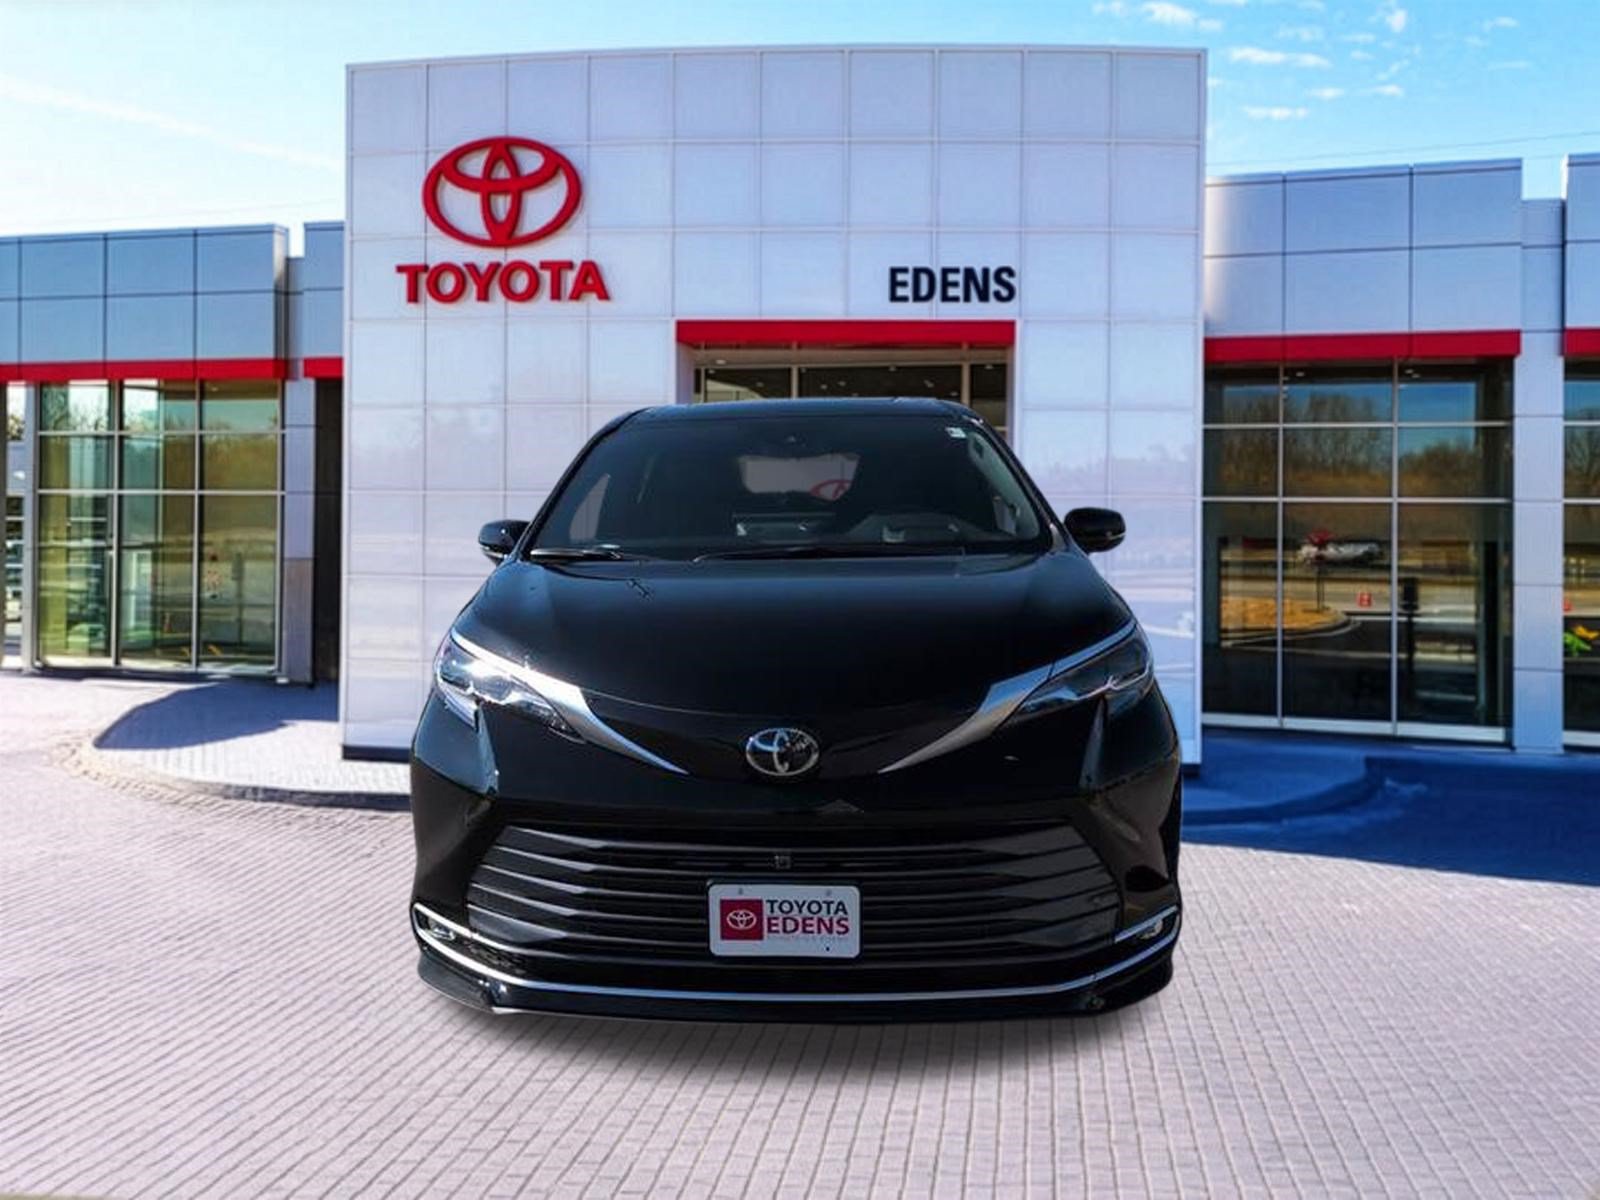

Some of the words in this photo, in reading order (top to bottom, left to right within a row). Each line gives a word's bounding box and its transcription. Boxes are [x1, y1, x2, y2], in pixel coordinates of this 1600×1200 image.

[396, 260, 611, 304] TOYOTA
[889, 265, 1017, 303] EDENS
[766, 899, 849, 915] TOYOTA
[766, 916, 849, 935] EDENS
